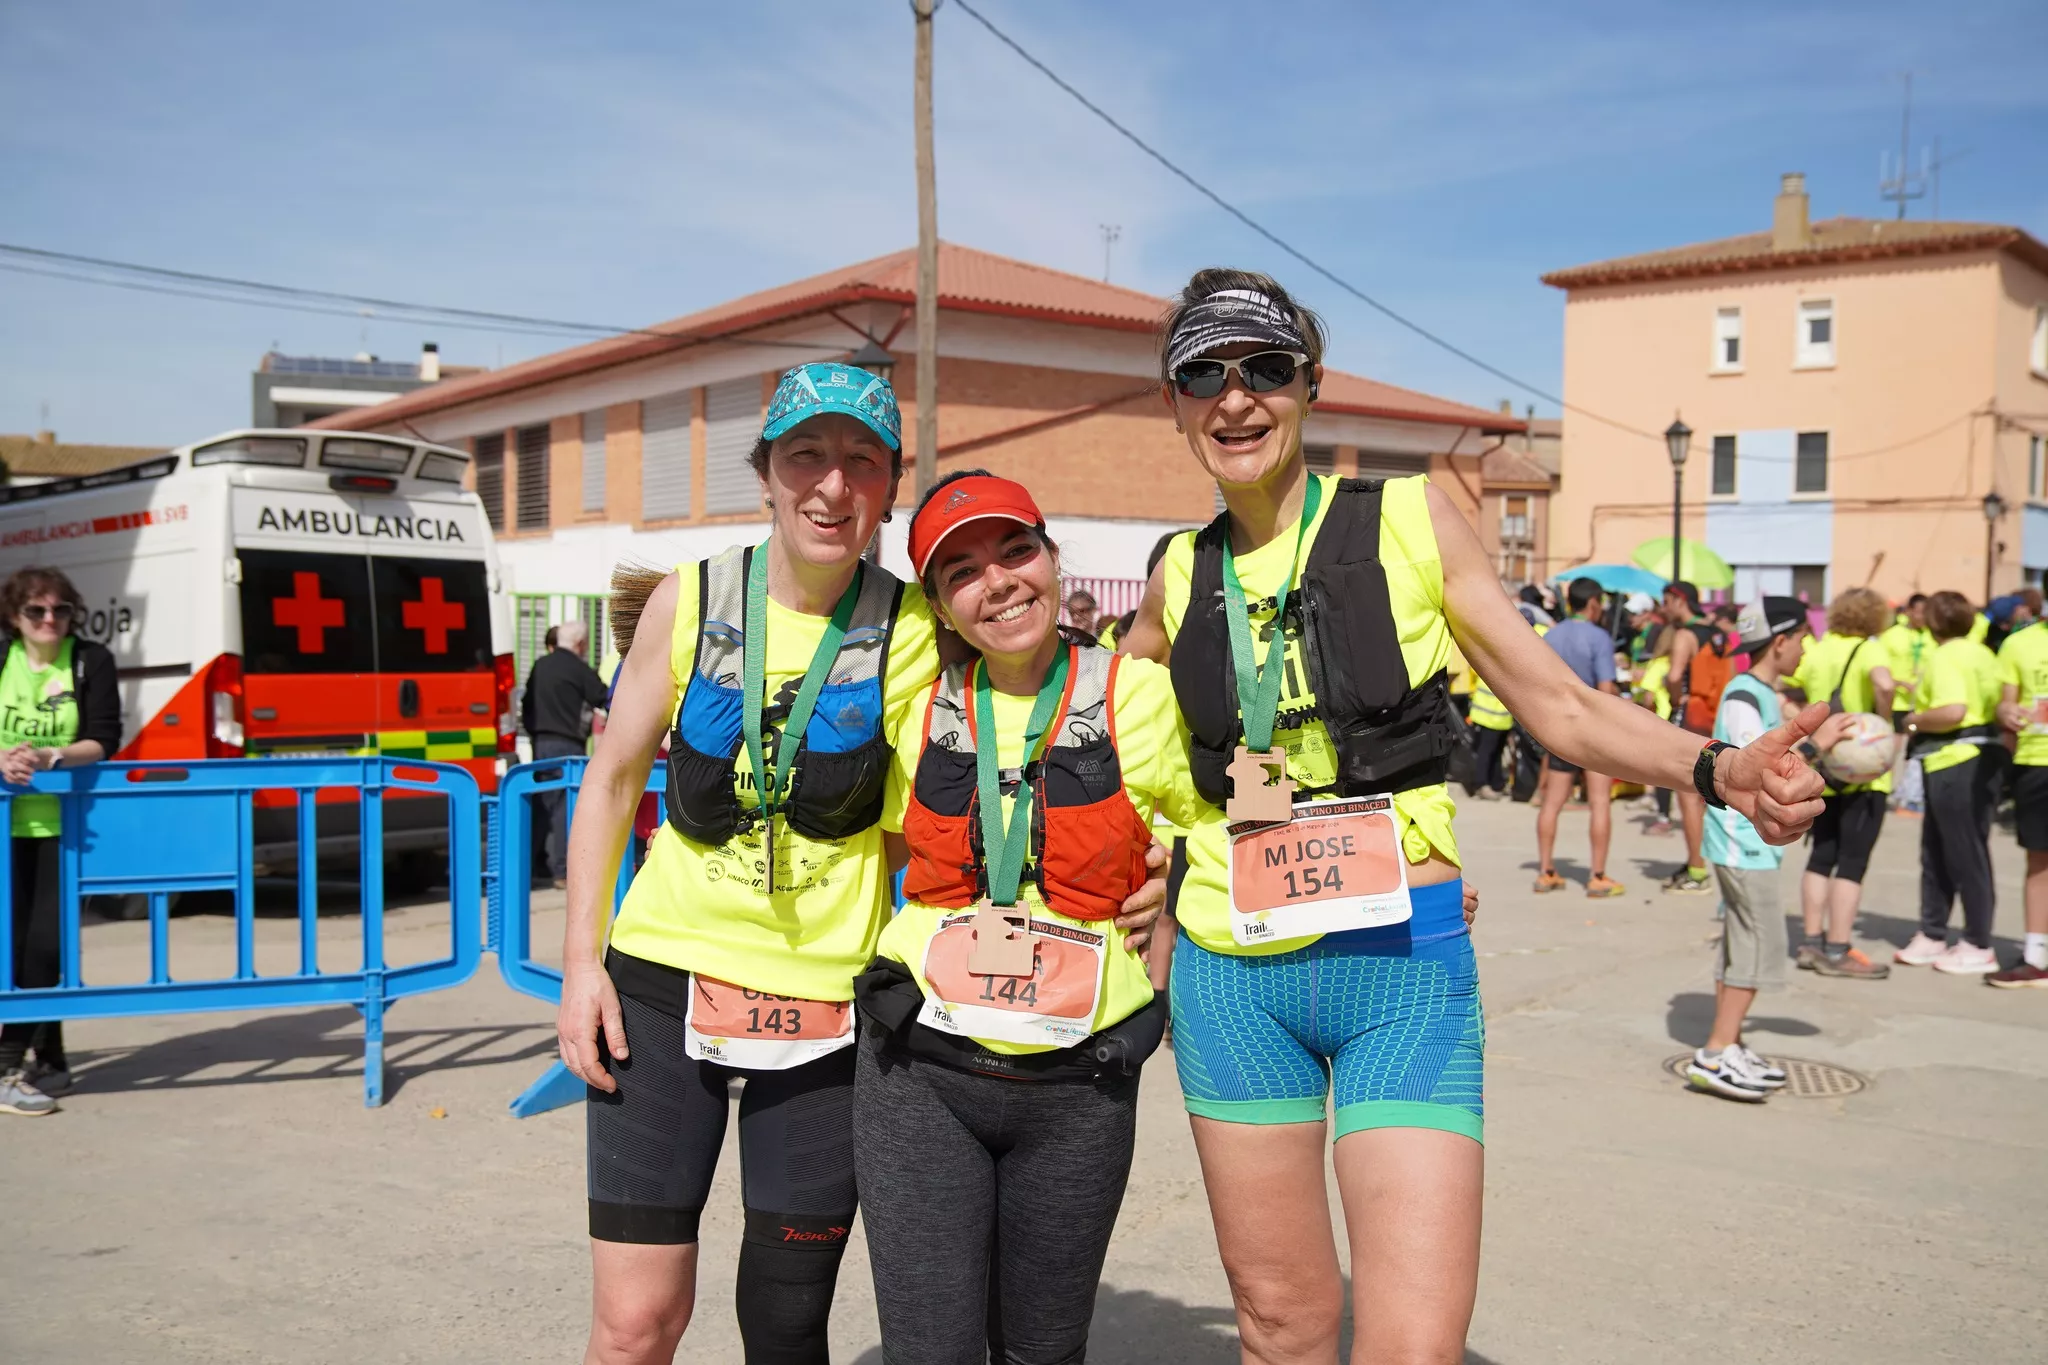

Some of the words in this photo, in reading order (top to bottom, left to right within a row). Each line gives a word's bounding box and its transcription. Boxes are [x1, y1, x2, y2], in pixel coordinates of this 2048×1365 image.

[1, 519, 93, 548] AMBULANCIA
[258, 507, 465, 541] AMBULANCIA
[4, 705, 56, 737] Trail
[1310, 806, 1333, 816] PINO
[1334, 804, 1347, 813] DE
[1348, 800, 1388, 812] BINACED
[1264, 844, 1288, 868] M
[1295, 835, 1356, 863] JOSE
[1283, 865, 1344, 899] 154
[1050, 925, 1061, 936] DE
[1062, 927, 1101, 945] BINACED
[1243, 922, 1266, 936] Trail
[979, 976, 1038, 1007] 144
[746, 1008, 802, 1035] 143
